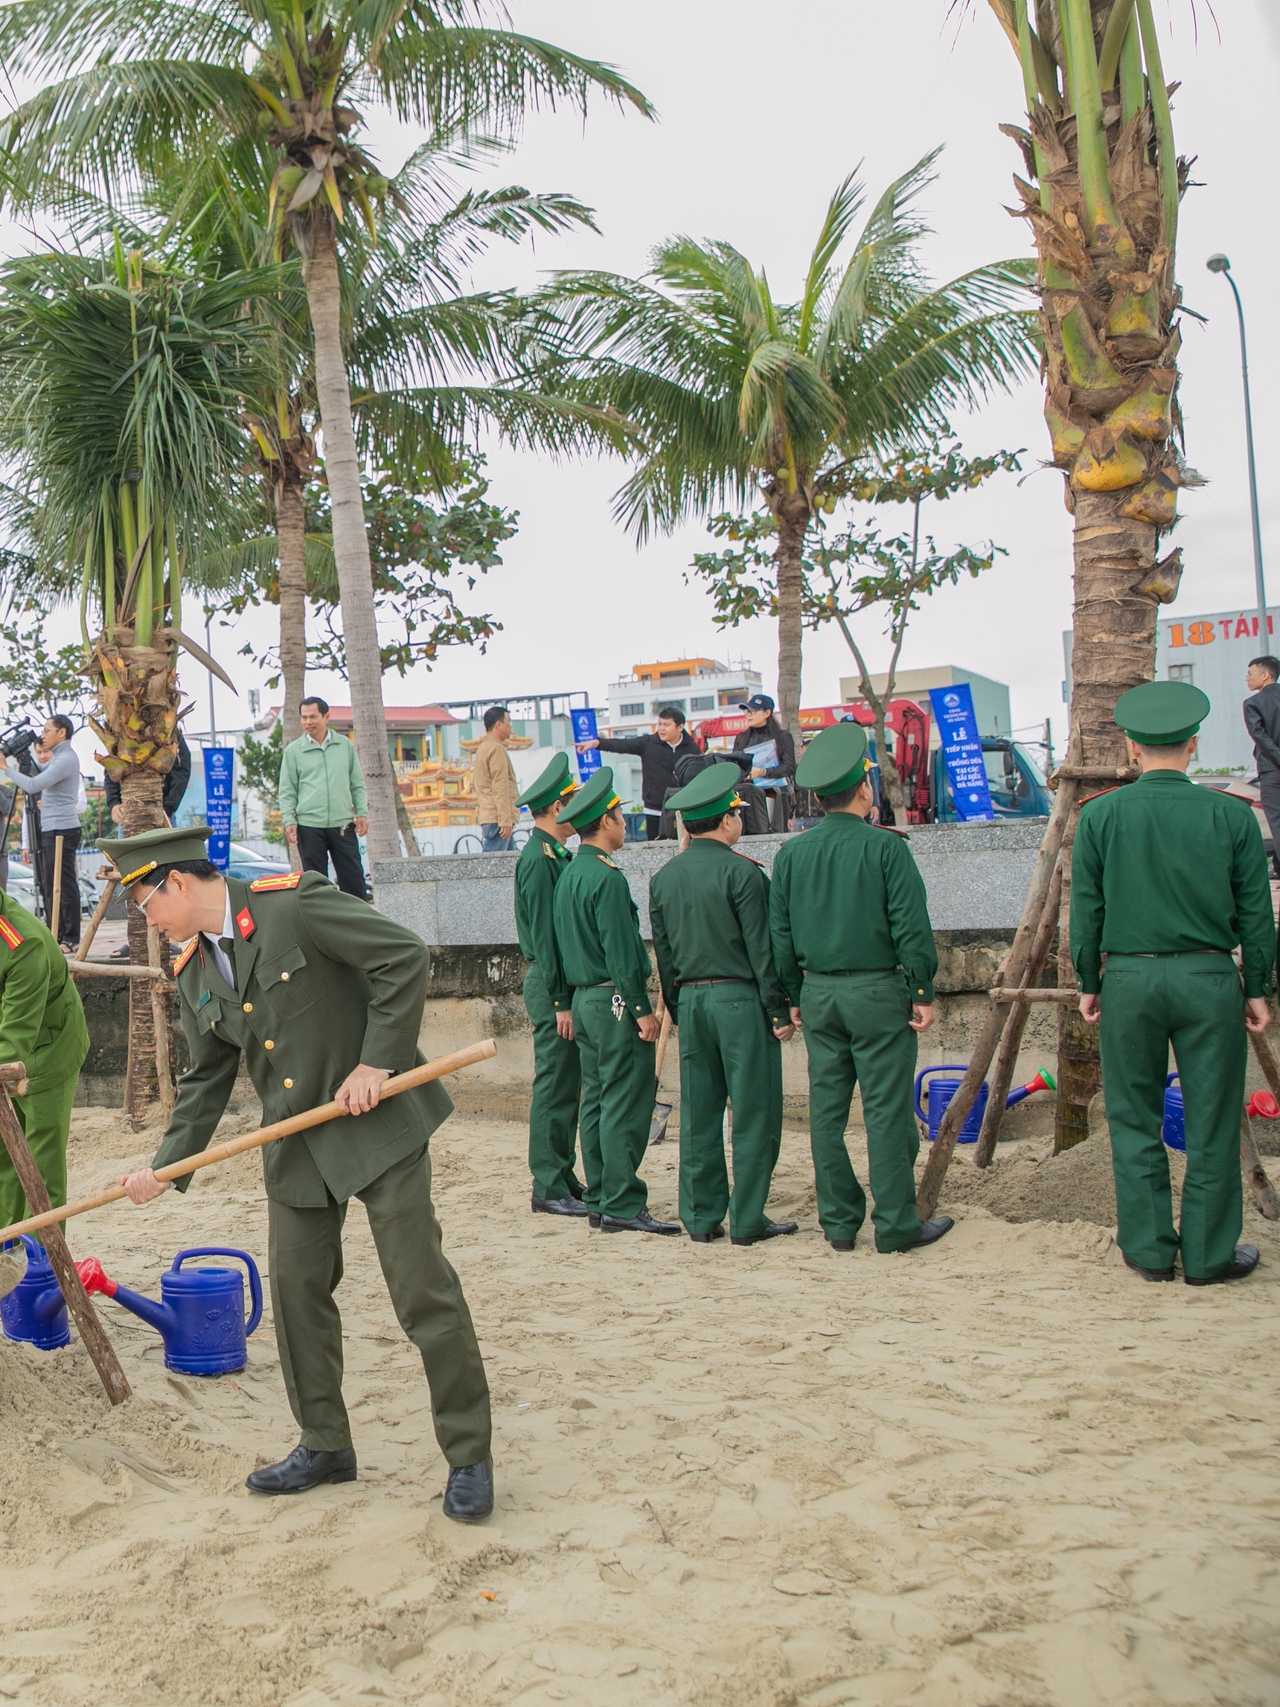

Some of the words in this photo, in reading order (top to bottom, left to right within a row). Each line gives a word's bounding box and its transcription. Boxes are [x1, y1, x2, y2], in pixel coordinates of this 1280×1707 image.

[1168, 621, 1215, 648] 18
[953, 727, 966, 742] LỄ
[214, 784, 224, 796] LỄ
